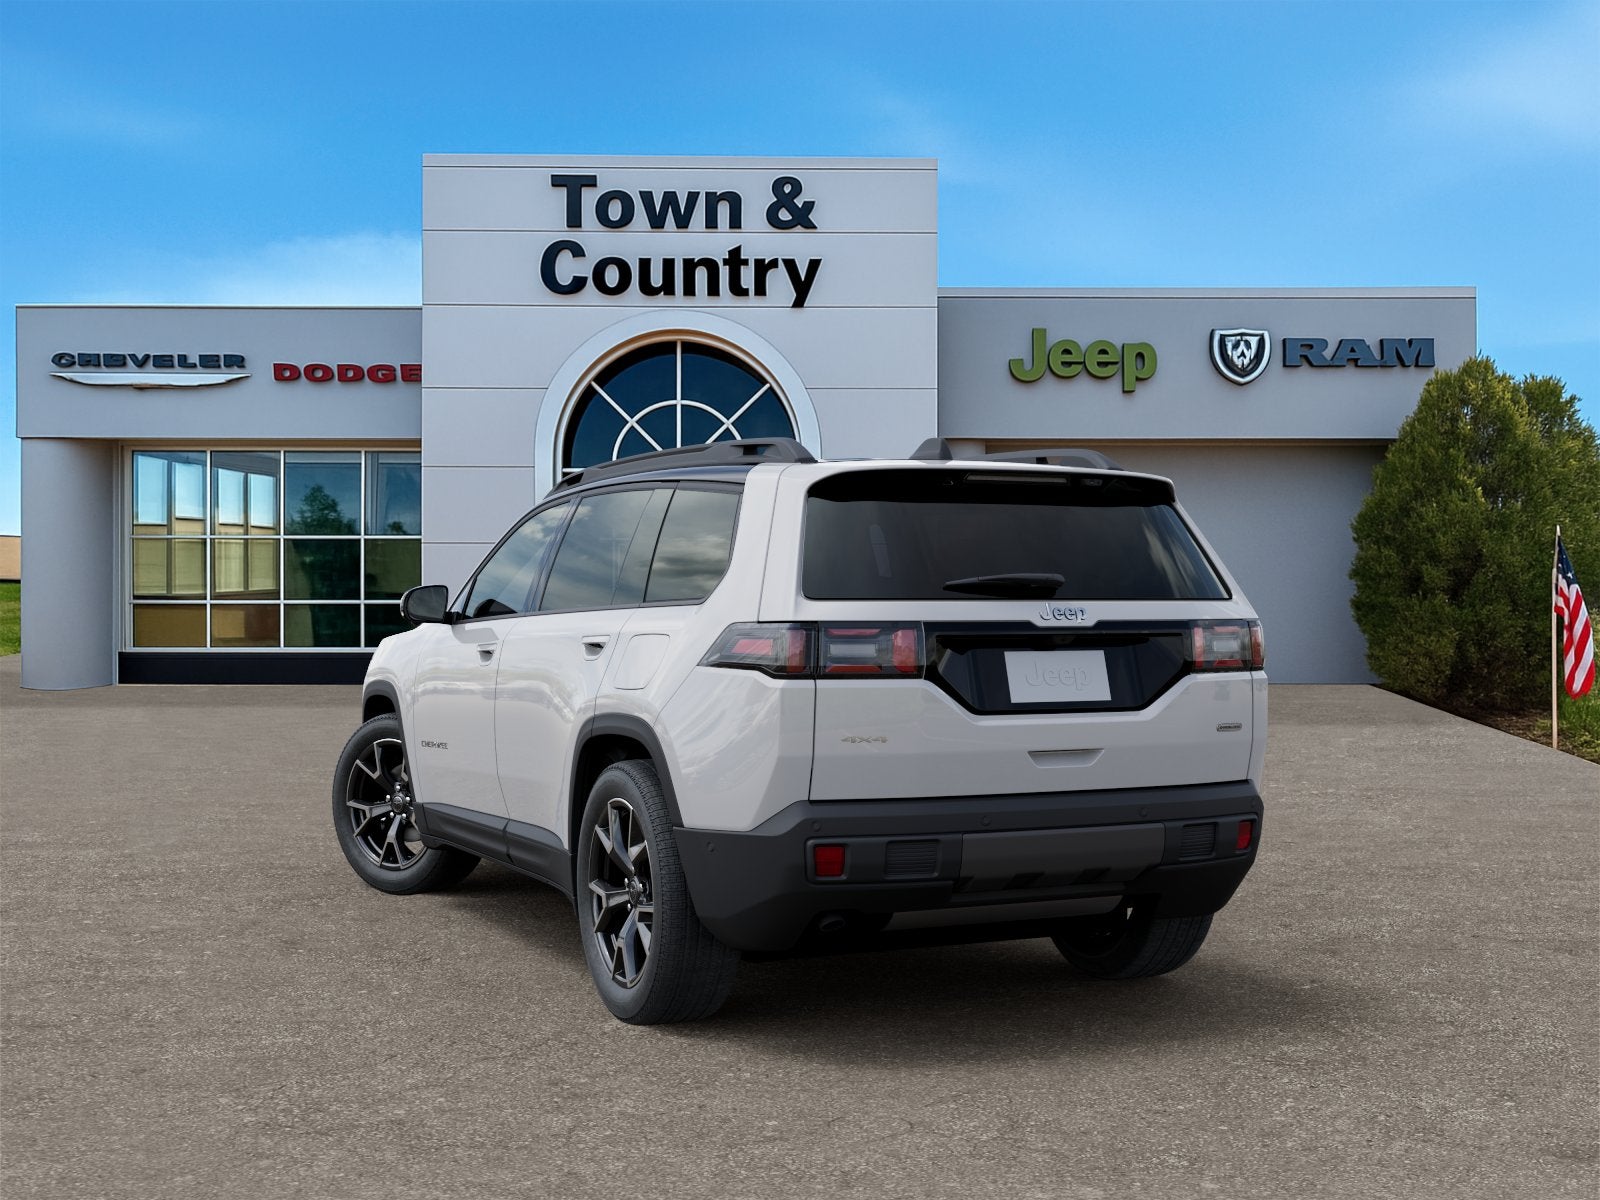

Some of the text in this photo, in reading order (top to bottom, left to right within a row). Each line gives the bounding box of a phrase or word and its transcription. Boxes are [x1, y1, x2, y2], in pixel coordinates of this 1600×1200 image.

[551, 174, 817, 229] Town &
[540, 239, 822, 308] Country
[1009, 327, 1157, 393] Jeep
[1282, 337, 1436, 368] RAM
[273, 362, 422, 383] DODGE
[1039, 602, 1087, 623] Jeep
[1025, 658, 1092, 692] Jeep
